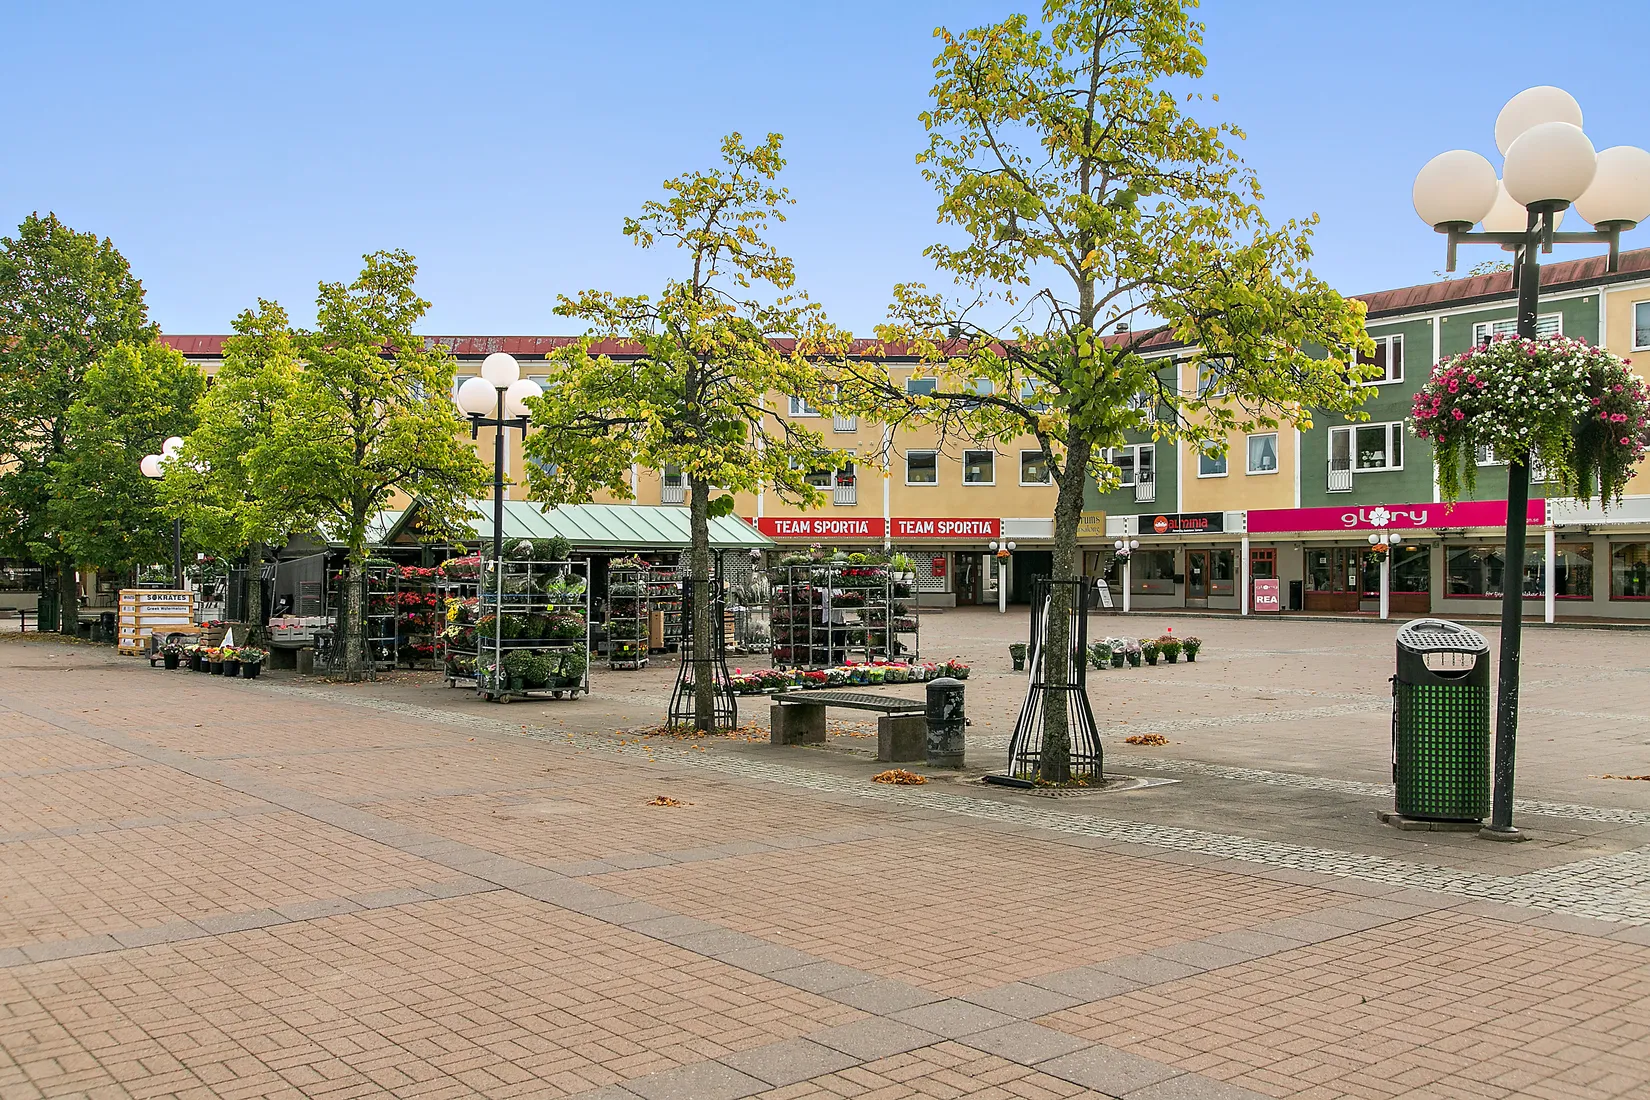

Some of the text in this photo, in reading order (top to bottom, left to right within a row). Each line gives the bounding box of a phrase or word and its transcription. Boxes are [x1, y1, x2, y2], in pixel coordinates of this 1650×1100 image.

[775, 520, 869, 534] TEAM SPORTIA
[899, 520, 992, 535] TEAM SPORTIA
[1256, 595, 1278, 604] REA
